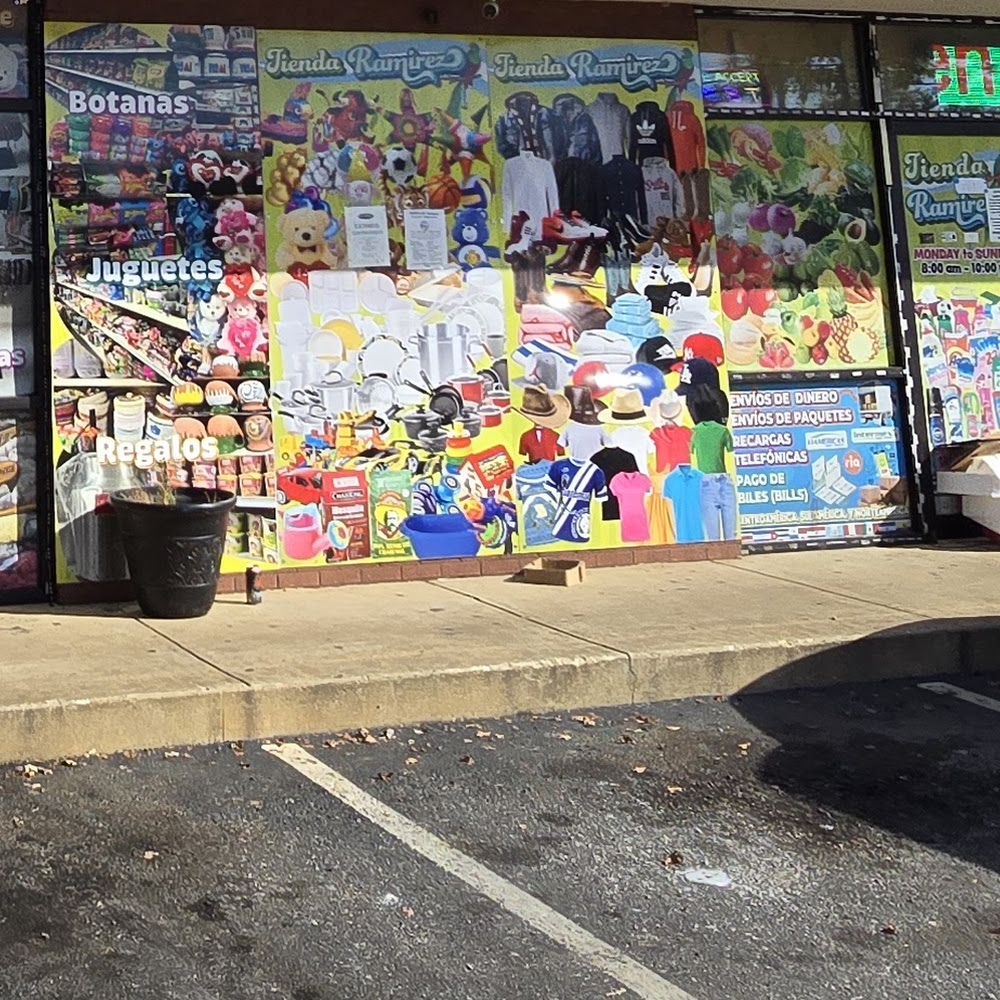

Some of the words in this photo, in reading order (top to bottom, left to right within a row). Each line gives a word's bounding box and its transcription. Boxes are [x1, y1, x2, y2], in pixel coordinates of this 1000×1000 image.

[266, 49, 344, 77] Tienda
[347, 45, 466, 86] Ramirez
[494, 53, 569, 81] Tienda
[569, 51, 679, 90] Ramirez
[69, 90, 189, 114] Botanas
[903, 152, 989, 183] Tienda
[906, 189, 987, 231] Ramire
[914, 248, 960, 260] MONDAY
[963, 248, 974, 260] to
[86, 257, 223, 286] Juguetes
[922, 262, 943, 274] 8:00
[946, 264, 962, 273] am
[971, 262, 998, 274] 10:00
[731, 390, 772, 407] ENVÍOS
[774, 392, 790, 406] DE
[795, 390, 838, 405] DINERO
[732, 409, 774, 427] ENVÍOS
[776, 411, 792, 425] DE
[794, 409, 852, 425] PAQUETES
[733, 433, 792, 447] RECARGAS
[96, 435, 219, 468] Regalos
[736, 449, 808, 466] TELEFÓNICAS
[845, 455, 860, 468] ria
[737, 473, 767, 487] PAGO
[769, 472, 785, 485] DE
[738, 490, 769, 504] BILES
[771, 488, 809, 505] (BILLS)
